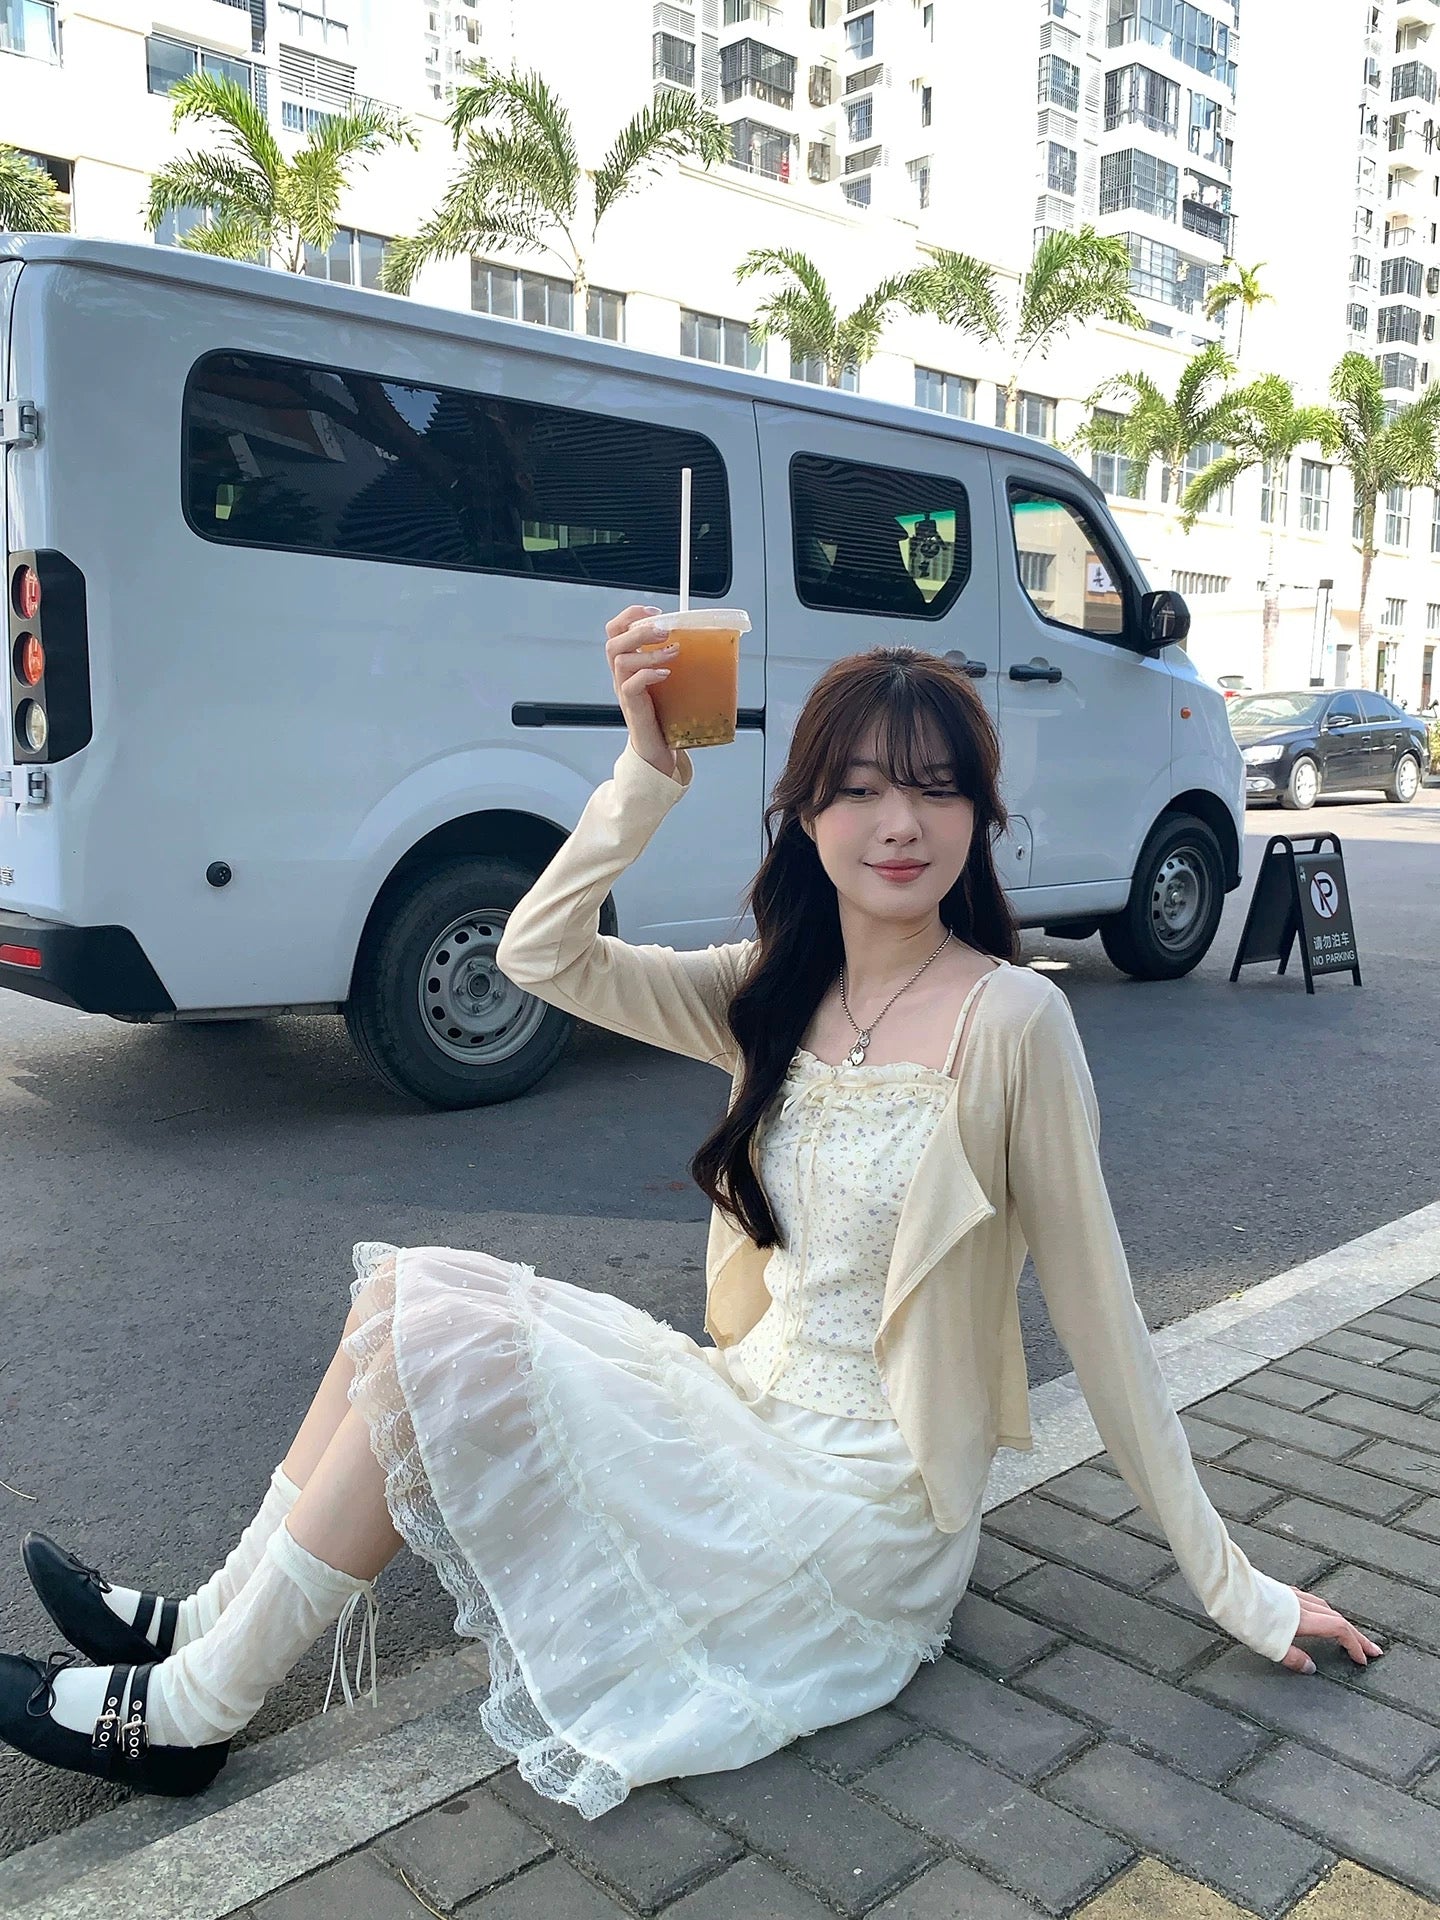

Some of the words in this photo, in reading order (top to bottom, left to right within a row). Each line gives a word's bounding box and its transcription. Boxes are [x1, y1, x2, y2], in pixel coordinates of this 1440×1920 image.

[1313, 932, 1350, 950] 请勿泊车
[1312, 955, 1324, 966] NO
[1325, 950, 1355, 964] PARKING
